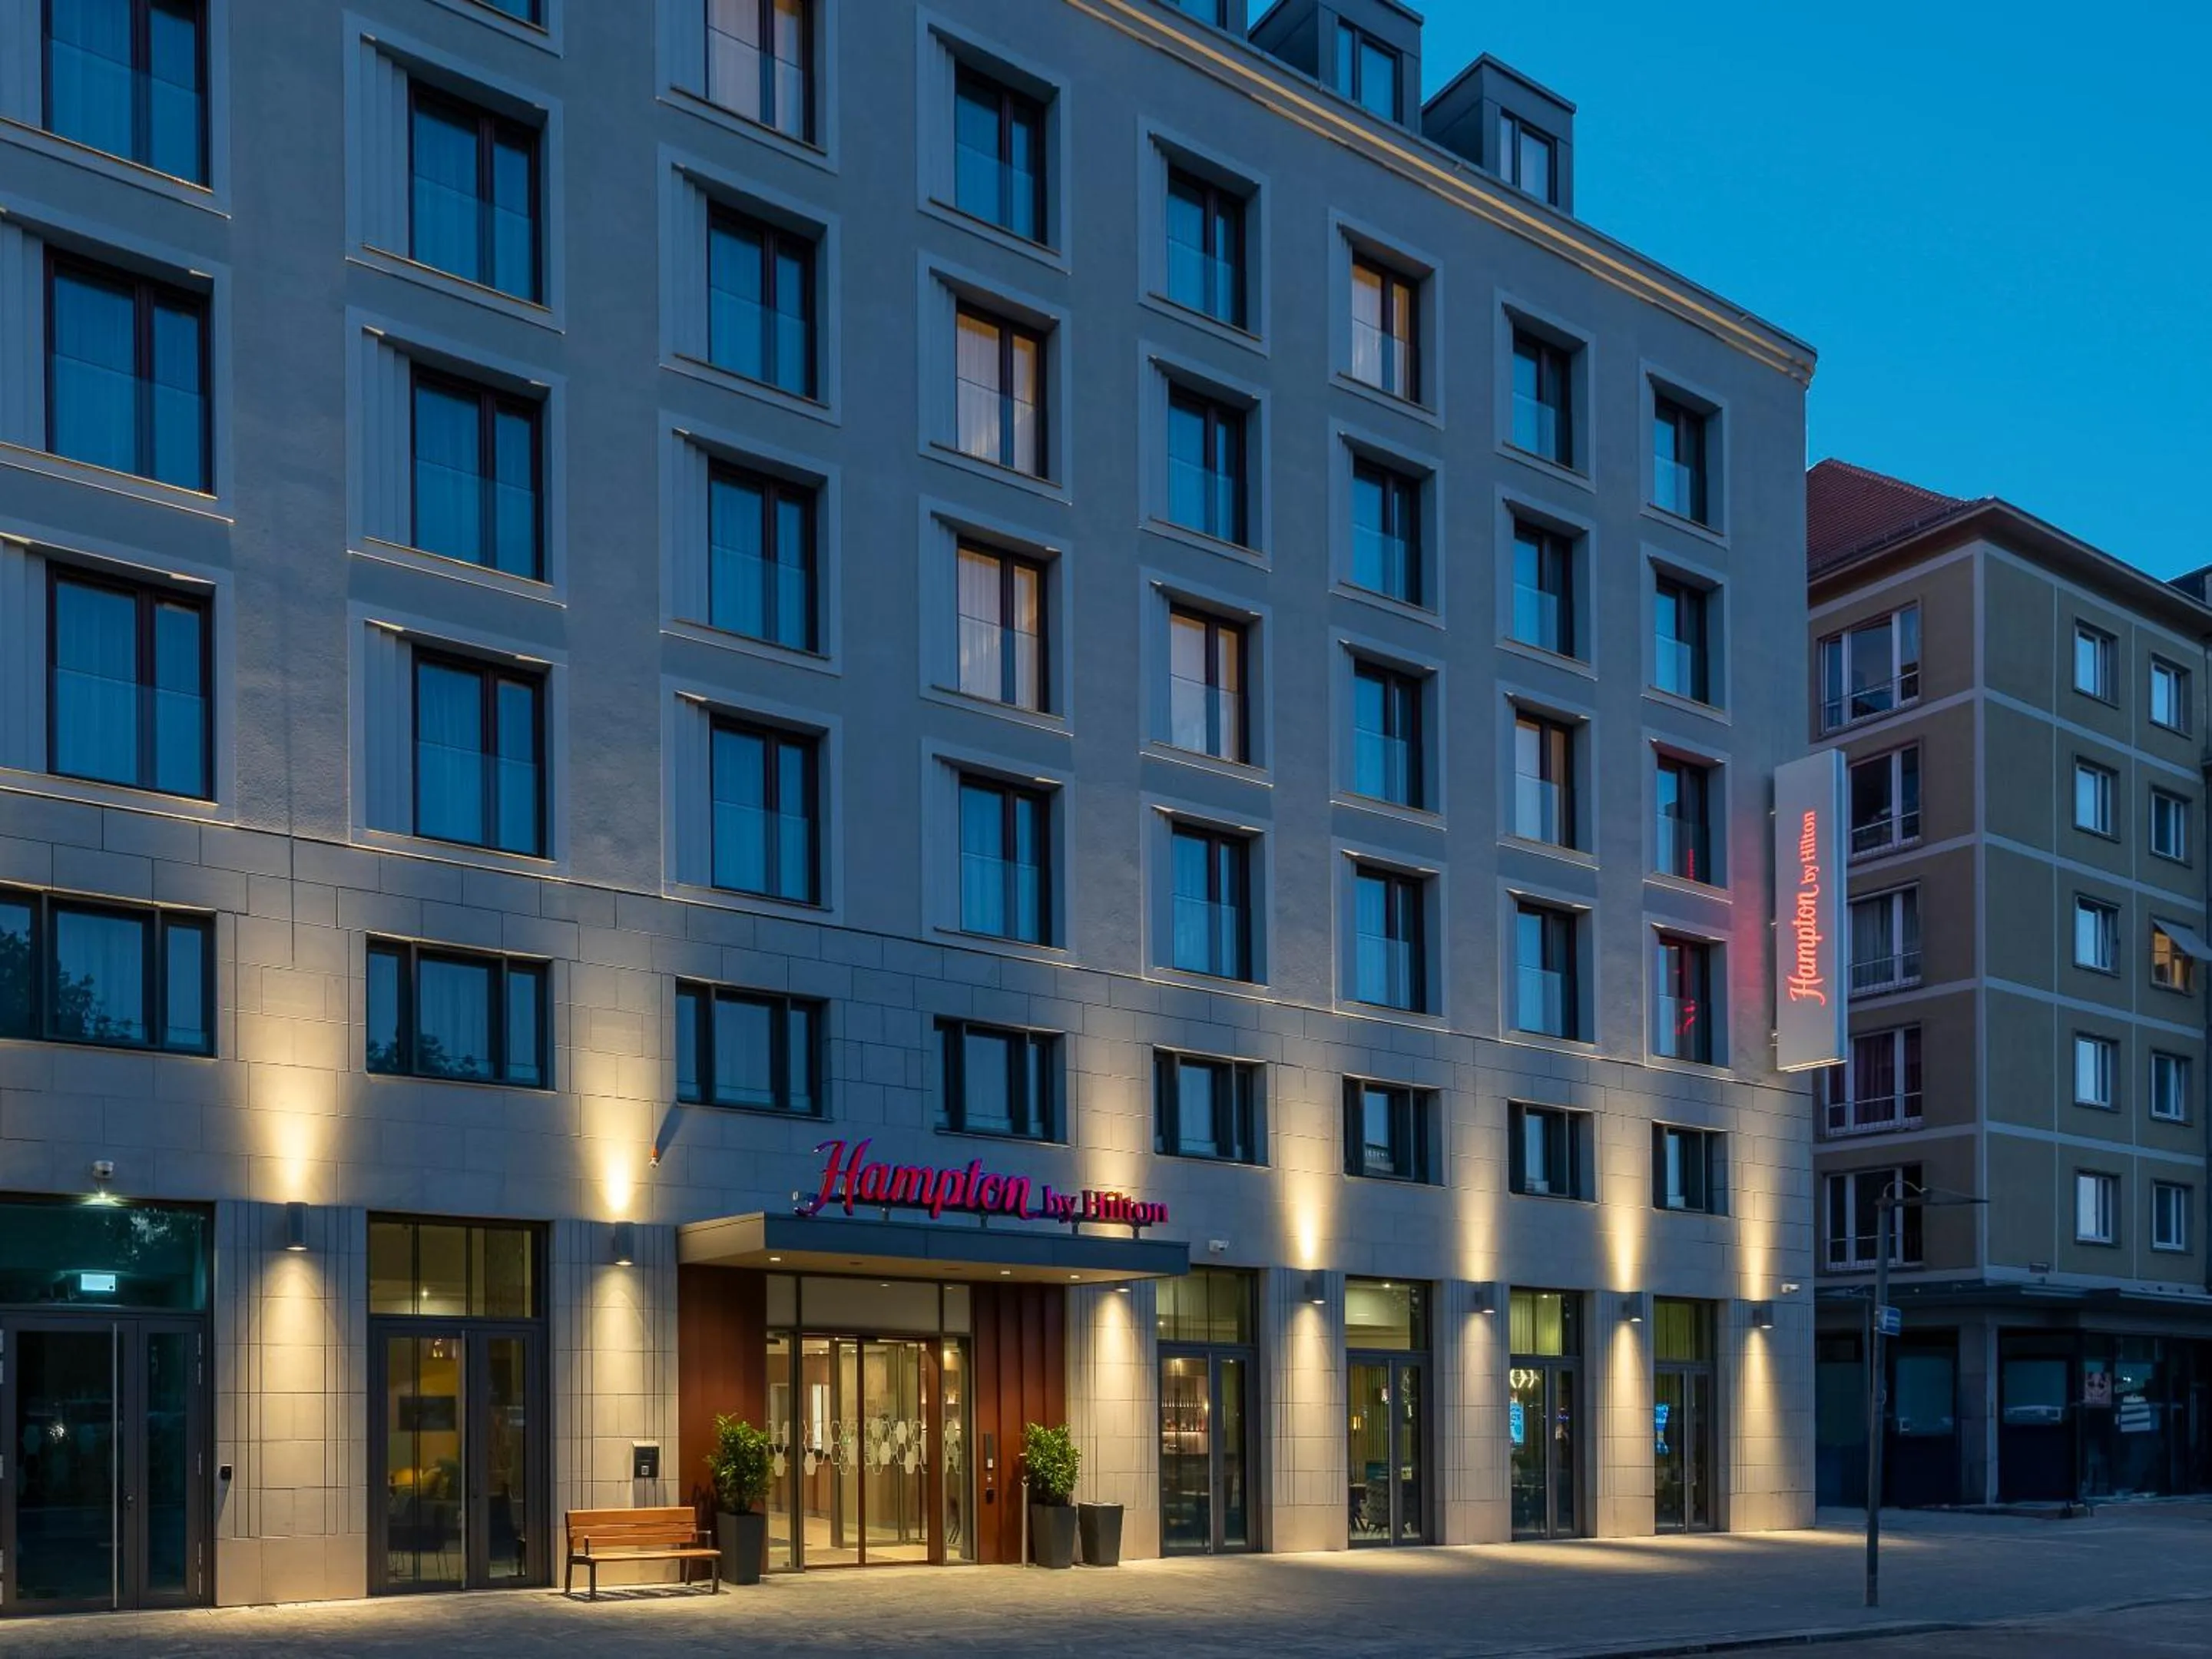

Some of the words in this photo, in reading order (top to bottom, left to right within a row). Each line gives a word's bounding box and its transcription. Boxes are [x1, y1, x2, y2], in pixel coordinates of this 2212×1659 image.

[1800, 810, 1816, 862] Hilton
[1800, 865, 1820, 885] by
[1786, 884, 1826, 1006] Hampton
[793, 1137, 1040, 1220] Hampton
[1041, 1185, 1077, 1224] by
[1081, 1189, 1169, 1227] Hilton
